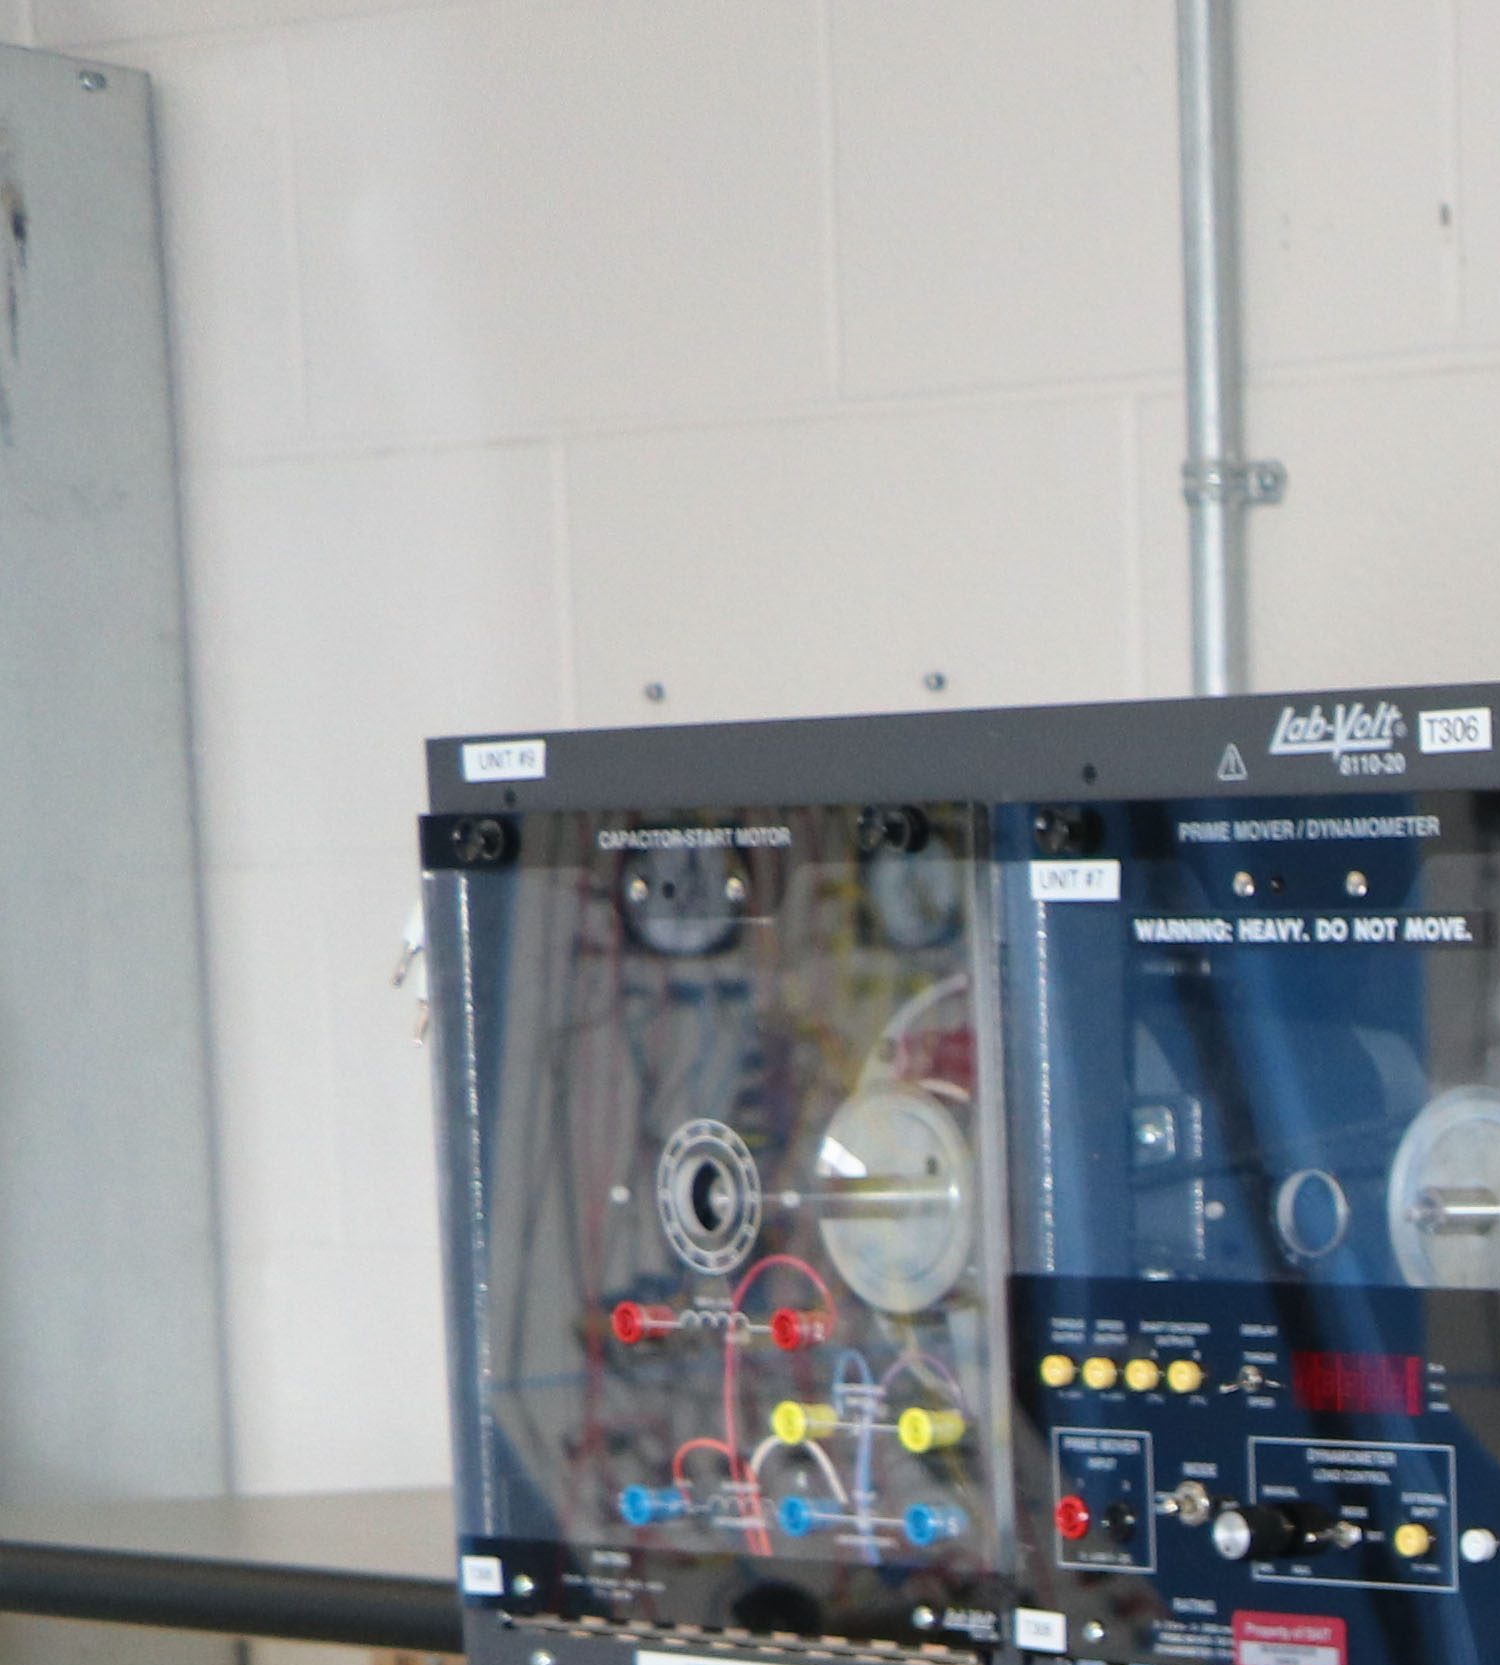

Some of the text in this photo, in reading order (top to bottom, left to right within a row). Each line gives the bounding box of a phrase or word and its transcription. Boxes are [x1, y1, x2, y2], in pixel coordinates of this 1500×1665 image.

[1424, 716, 1480, 744] T306
[1179, 821, 1230, 842] PRIME
[1233, 819, 1294, 841] MOVER
[1305, 816, 1441, 839] DYNAMOMETER
[1039, 869, 1079, 891] UNIT
[1133, 917, 1473, 943] WARNING: HEAVY. DO NOT MOVE.
